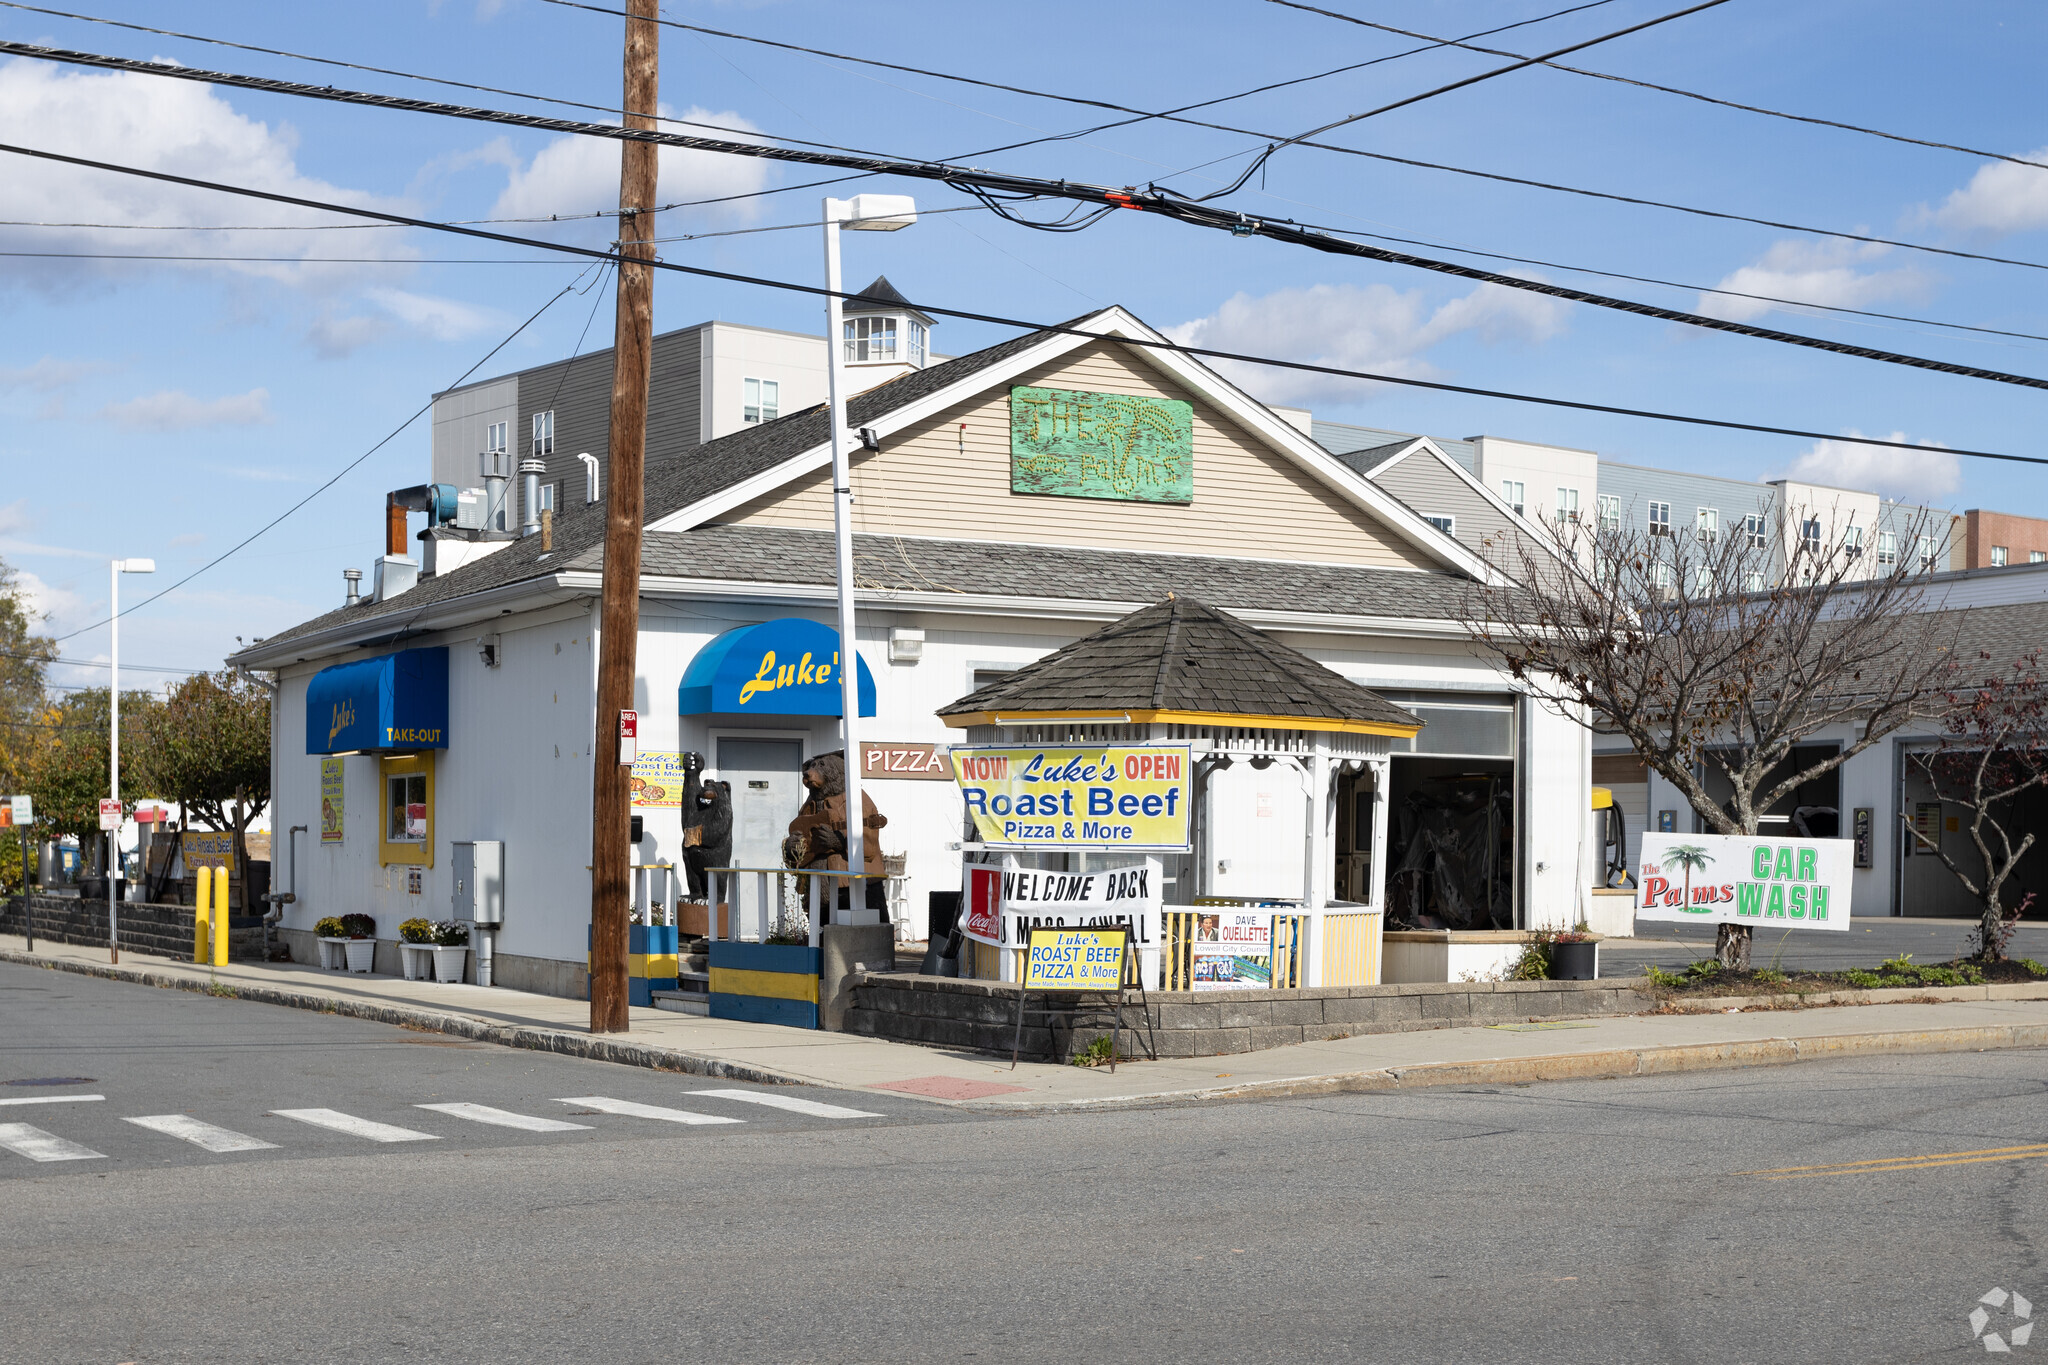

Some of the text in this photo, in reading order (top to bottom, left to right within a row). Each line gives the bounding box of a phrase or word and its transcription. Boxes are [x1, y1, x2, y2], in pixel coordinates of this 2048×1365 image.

[1023, 398, 1094, 442] THE
[739, 650, 842, 704] Luke'
[328, 697, 355, 749] Luke's
[621, 713, 636, 721] AREA
[386, 727, 441, 742] TAKE-OUT
[637, 753, 680, 763] Luke's
[866, 749, 944, 773] PIZZA
[961, 753, 1180, 783] NOW Luke's OPEN
[962, 787, 1179, 817] Roast Beef
[1005, 821, 1133, 839] Pizza & More
[197, 836, 216, 854] Roast
[217, 835, 232, 854] Beef
[1641, 863, 1660, 876] The
[1752, 845, 1818, 882] CAR
[1003, 869, 1149, 901] WELCOME BACK
[1736, 882, 1830, 920] WASH
[1001, 915, 1006, 943] U
[1235, 915, 1256, 925] DAVE
[1057, 933, 1099, 945] Luke's
[1222, 926, 1268, 941] OUELLETTE
[1032, 947, 1121, 962] ROAST BEEF
[1222, 945, 1238, 953] City
[1032, 964, 1118, 979] PIZZA & More
